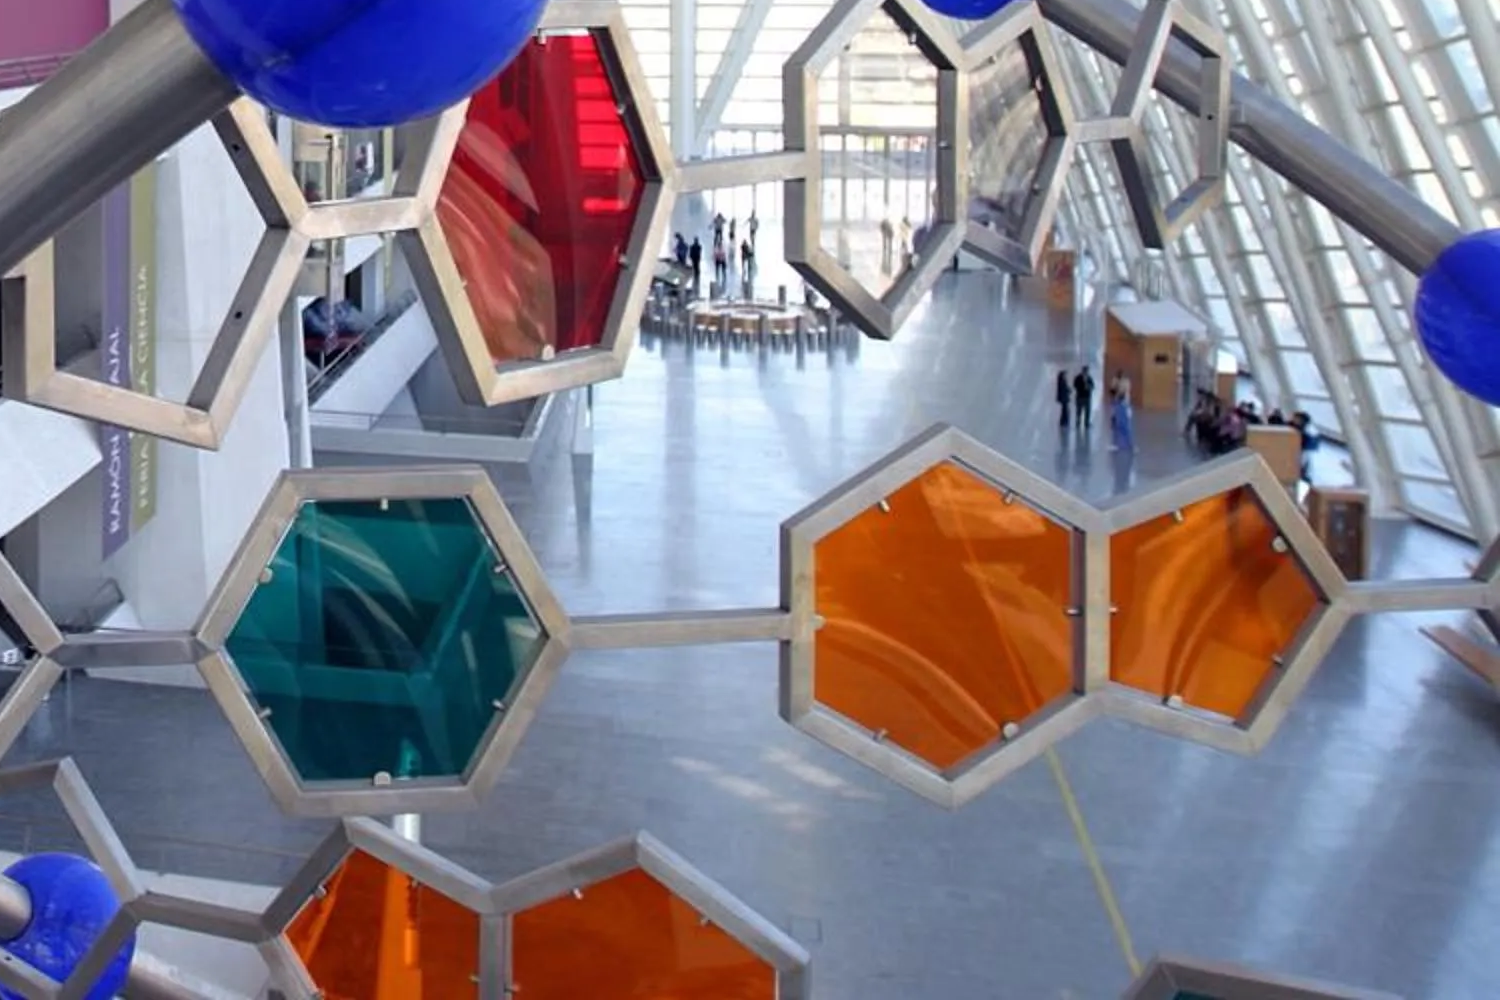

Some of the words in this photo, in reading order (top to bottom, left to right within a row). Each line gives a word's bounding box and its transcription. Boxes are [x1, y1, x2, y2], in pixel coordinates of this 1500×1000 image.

[109, 327, 121, 385] AJAL
[136, 264, 148, 363] CIENCIA
[109, 434, 121, 535] RAMÓN
